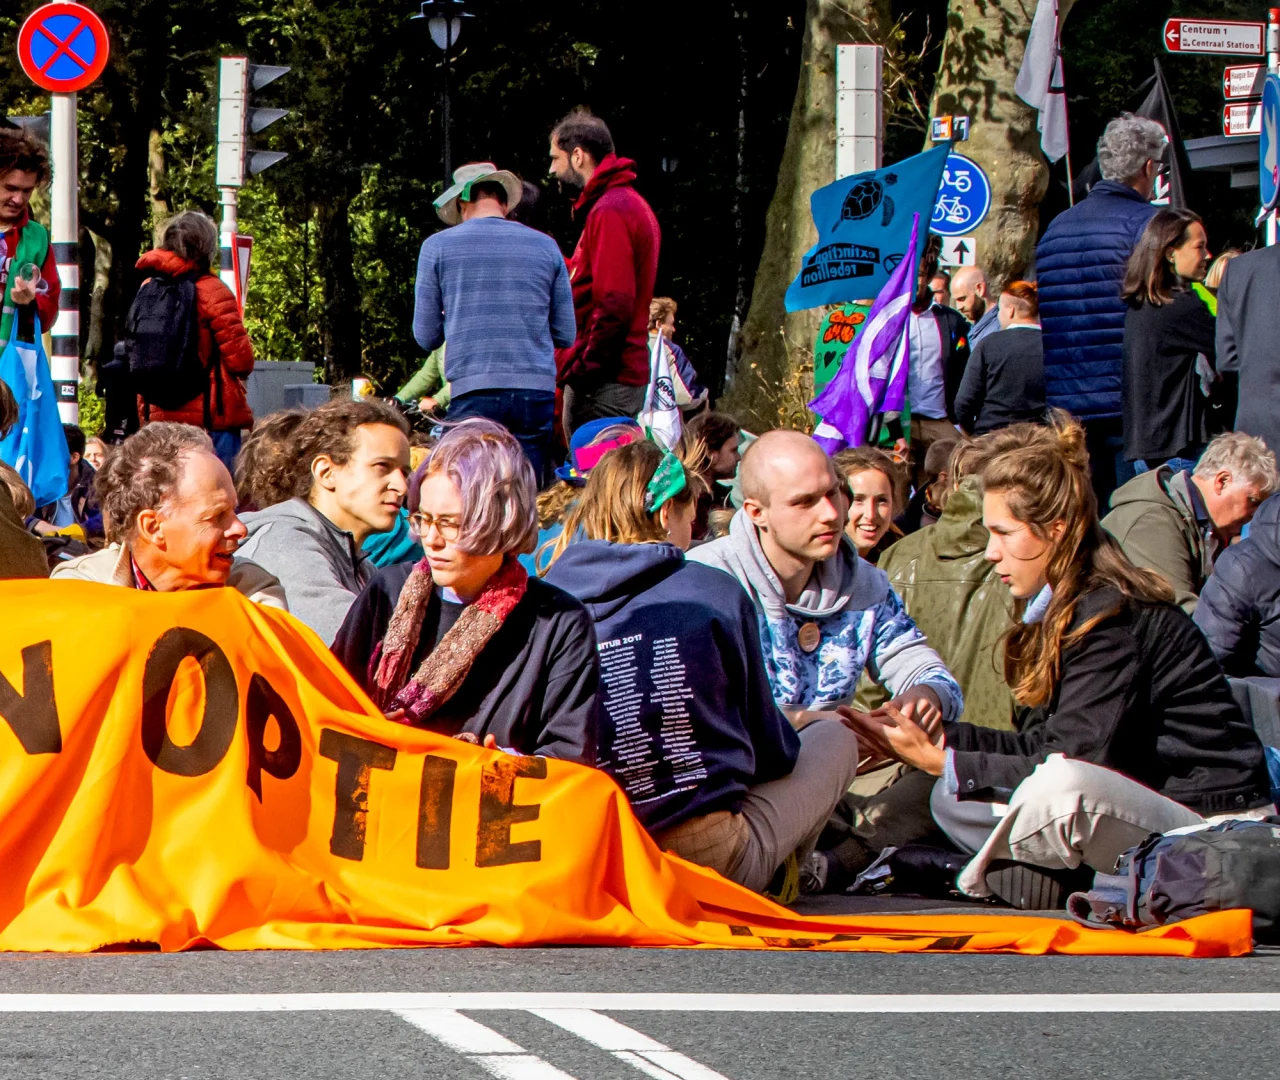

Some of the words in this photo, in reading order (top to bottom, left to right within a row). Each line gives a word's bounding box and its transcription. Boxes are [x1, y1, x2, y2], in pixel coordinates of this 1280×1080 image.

[1182, 25, 1220, 34] Centrum
[1191, 39, 1224, 48] Centraal
[1226, 41, 1255, 49] Station
[622, 634, 642, 644] 2017
[141, 626, 547, 871] OPTIE
